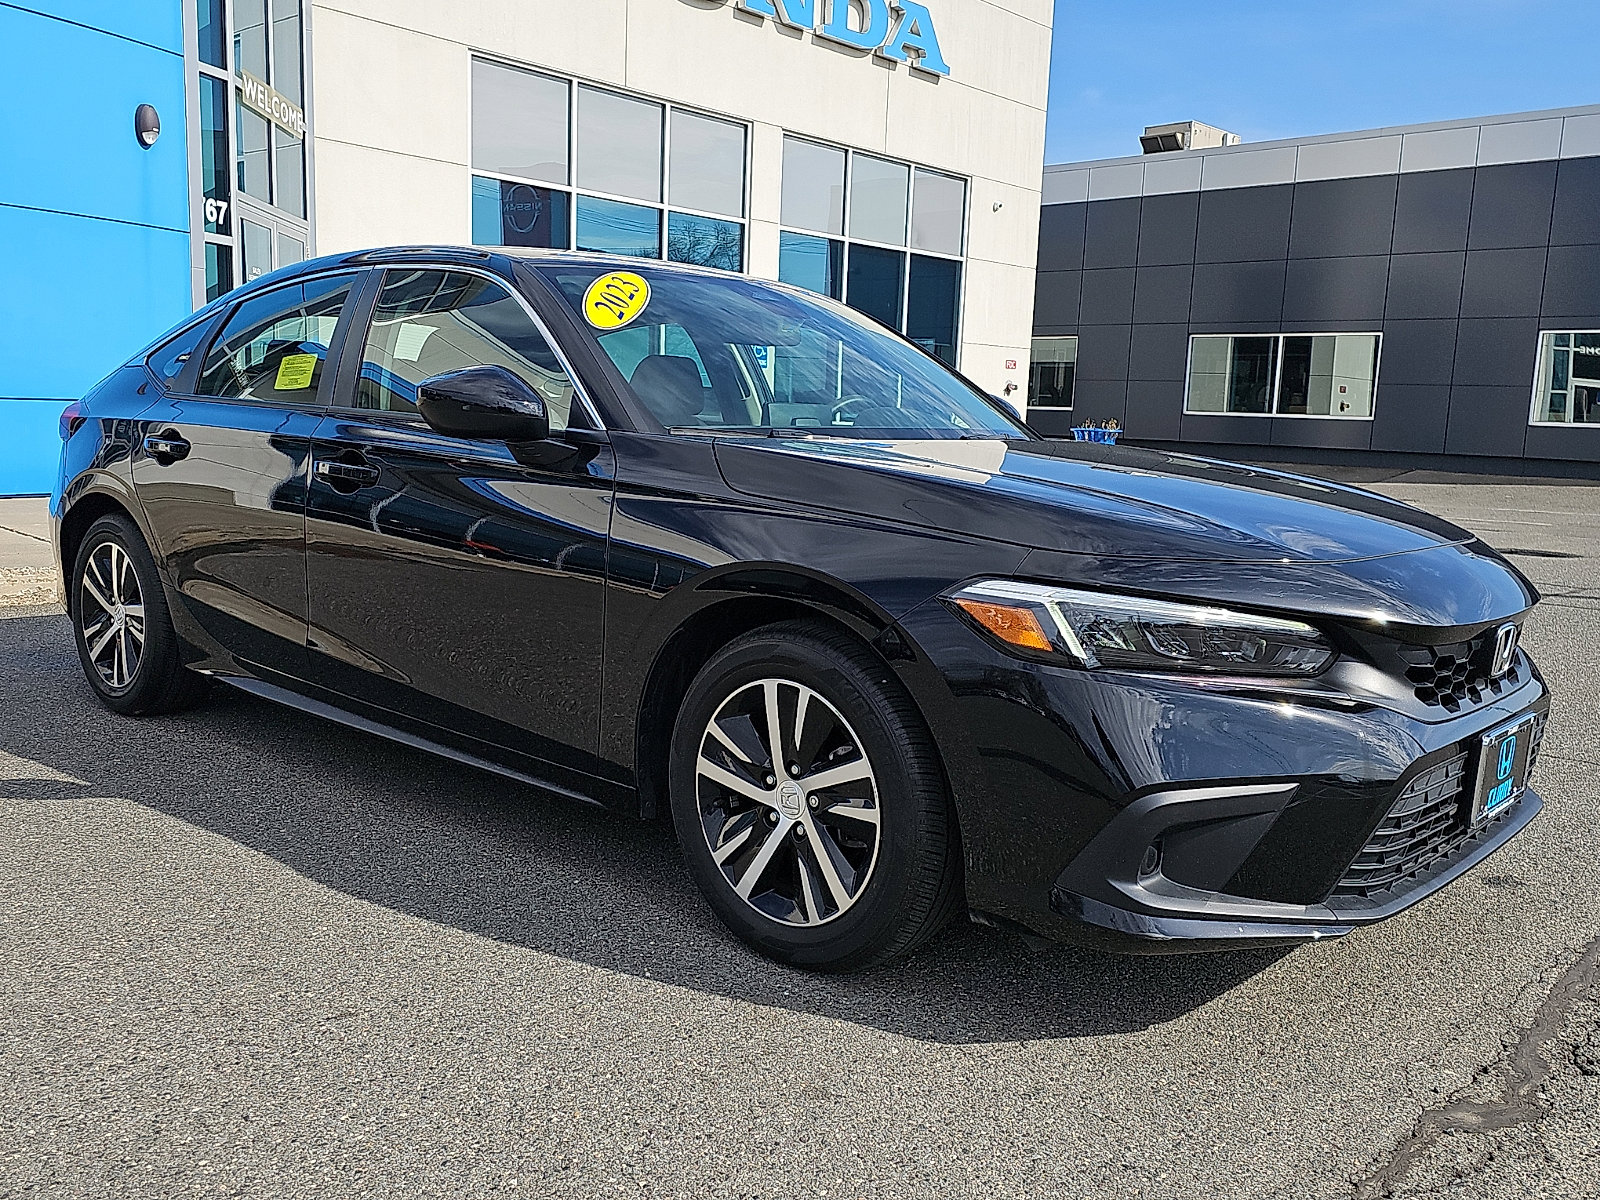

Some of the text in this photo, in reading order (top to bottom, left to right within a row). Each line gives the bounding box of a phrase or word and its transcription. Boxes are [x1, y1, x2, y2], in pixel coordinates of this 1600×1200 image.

[243, 74, 304, 135] WELCOME
[203, 197, 228, 225] 67
[594, 276, 640, 320] 2023
